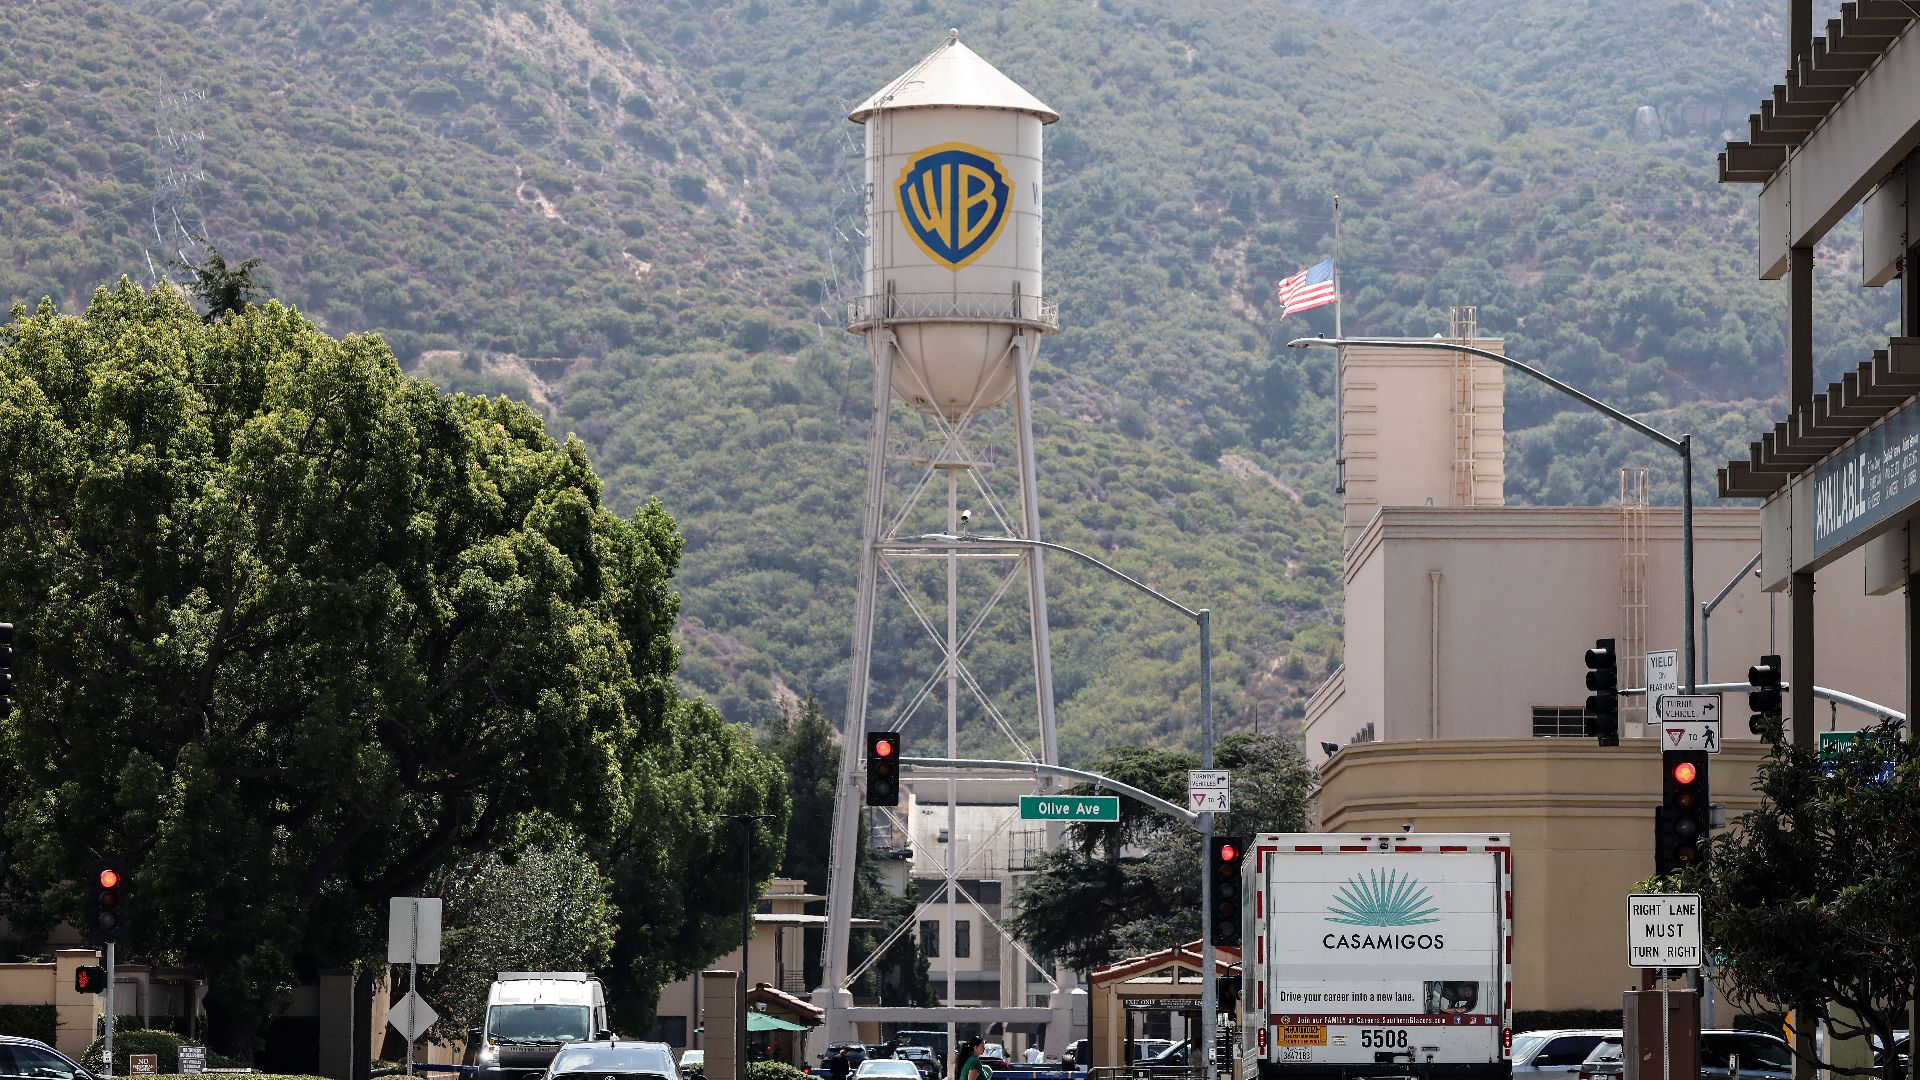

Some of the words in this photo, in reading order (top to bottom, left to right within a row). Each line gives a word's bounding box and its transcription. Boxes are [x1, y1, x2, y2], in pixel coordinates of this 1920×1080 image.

[907, 163, 998, 250] WB
[1816, 452, 1866, 541] AVAILABLE
[1650, 655, 1674, 669] YIELD
[1649, 682, 1676, 692] FLASHING
[1688, 733, 1698, 741] TO
[1038, 801, 1070, 815] Olive
[1076, 802, 1100, 815] Ave
[1633, 904, 1661, 915] RIGHT
[1669, 904, 1696, 915] LANE
[1645, 923, 1684, 937] MUST
[1322, 933, 1444, 949] CASAMIGOS
[1632, 946, 1659, 957] TURN
[1667, 946, 1697, 957] RIGHT
[1280, 991, 1302, 1002] Drive
[1303, 993, 1322, 1003] your
[1323, 993, 1350, 1002] career
[1351, 991, 1368, 1002] into
[1369, 994, 1375, 1002] a
[1376, 994, 1393, 1002] new
[1395, 991, 1415, 1002] lane.
[1297, 1016, 1311, 1024] Join
[1324, 1016, 1346, 1024] FAMILY
[1361, 1029, 1408, 1048] 5508
